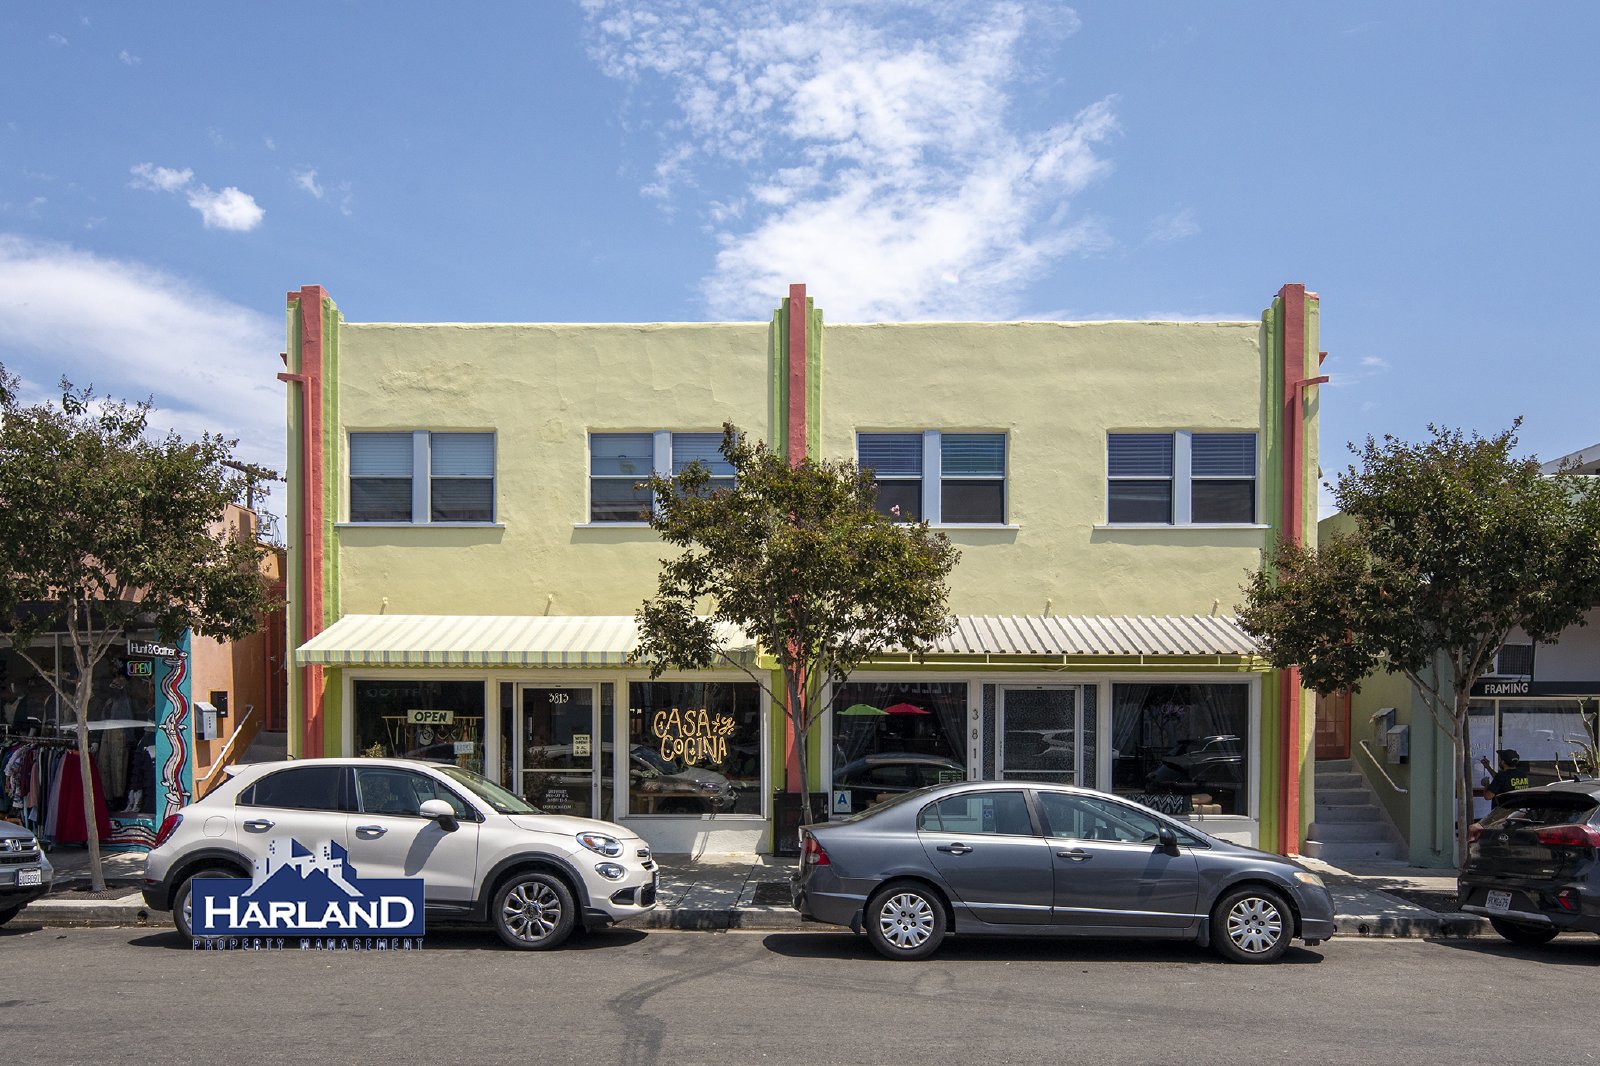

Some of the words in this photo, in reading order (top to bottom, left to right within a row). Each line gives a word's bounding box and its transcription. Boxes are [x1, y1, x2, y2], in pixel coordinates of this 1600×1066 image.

[129, 663, 150, 673] OPEN
[1484, 683, 1529, 694] FRAMING
[548, 693, 569, 704] 3813
[414, 711, 447, 722] OPEN
[653, 708, 712, 738] CASA
[660, 735, 728, 766] COCINA
[838, 792, 848, 806] A
